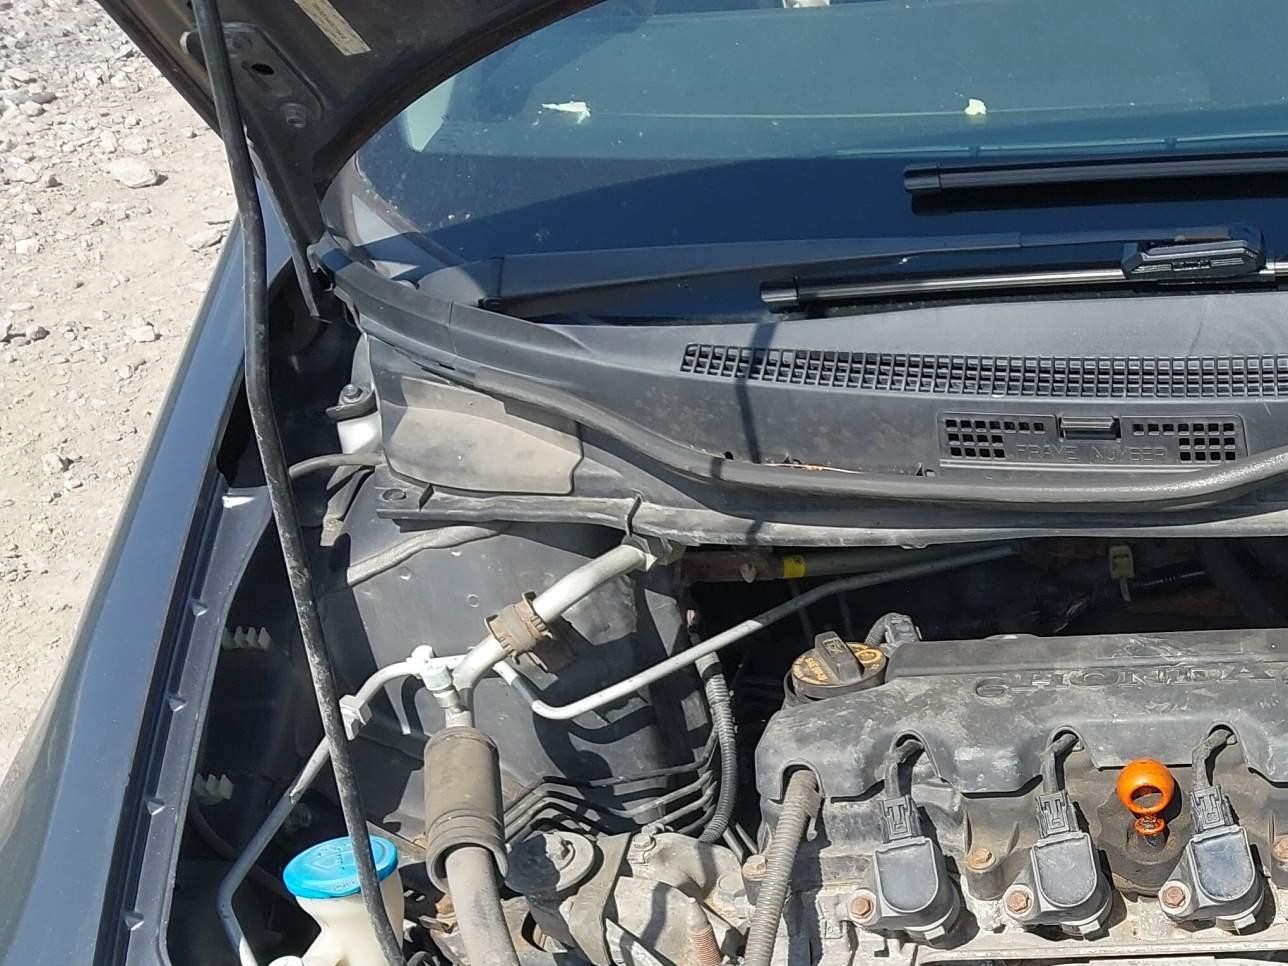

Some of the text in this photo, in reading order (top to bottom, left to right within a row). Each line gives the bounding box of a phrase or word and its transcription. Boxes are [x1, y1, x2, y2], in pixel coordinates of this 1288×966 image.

[1016, 444, 1168, 461] FRAME NUMBER
[1012, 666, 1277, 691] HONDA
